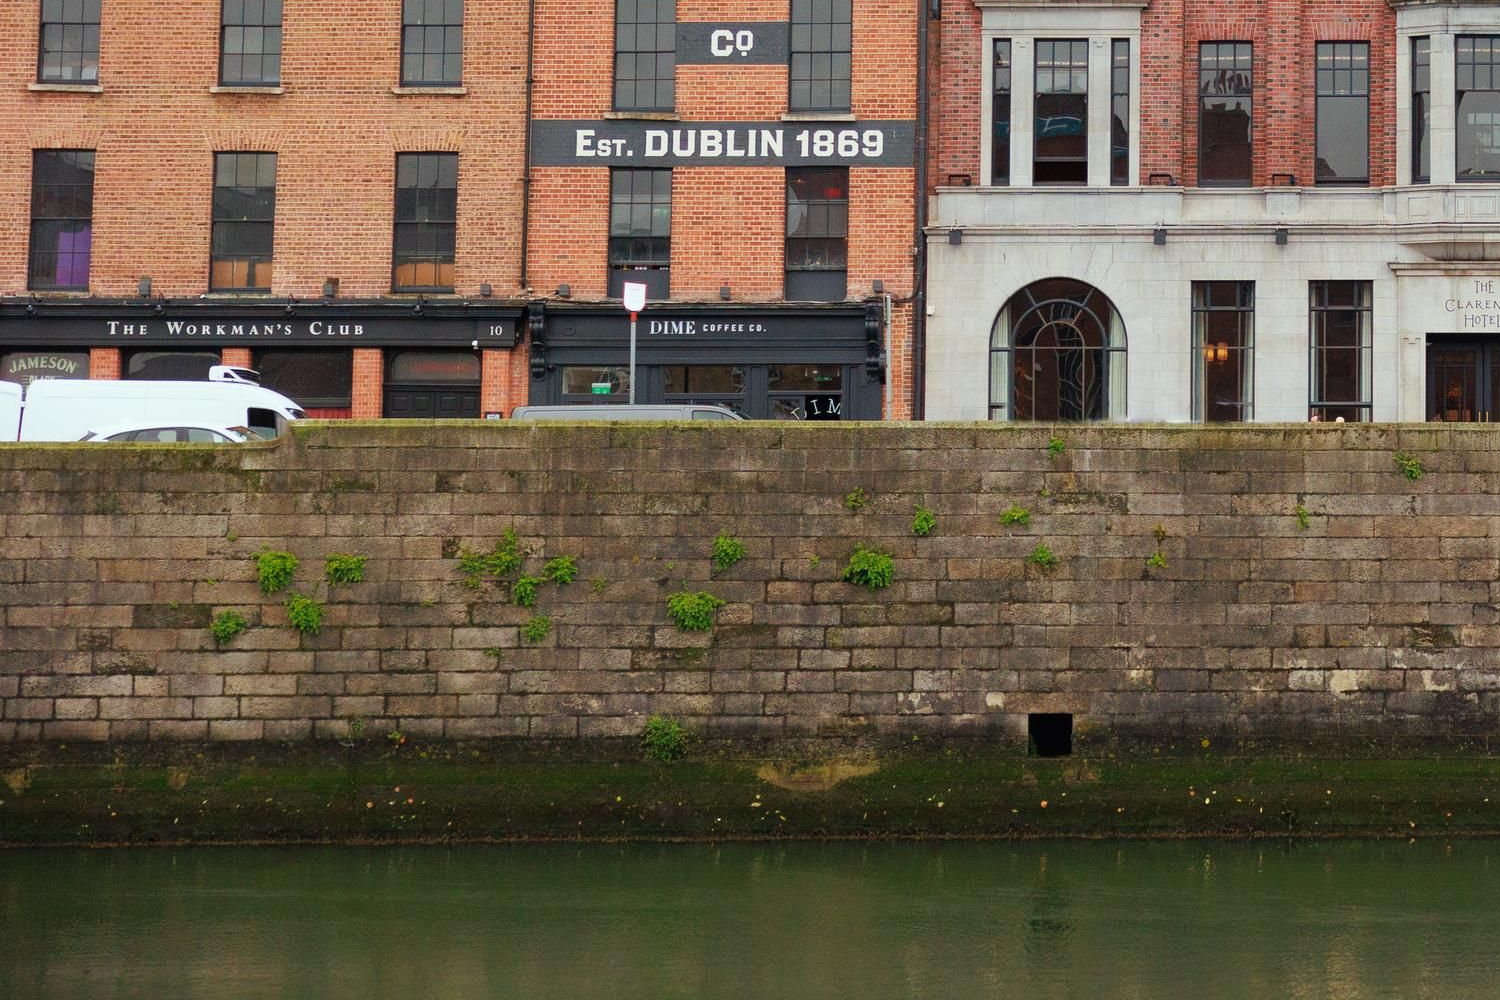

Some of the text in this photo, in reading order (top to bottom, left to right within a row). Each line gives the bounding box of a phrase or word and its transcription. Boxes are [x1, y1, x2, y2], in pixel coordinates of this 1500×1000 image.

[645, 129, 784, 157] DUBLIN
[795, 129, 884, 157] 1869
[1474, 280, 1495, 294] THE
[107, 321, 148, 335] THE
[309, 321, 364, 335] CLUB
[489, 325, 503, 336] 10
[649, 320, 767, 335] DIME COFFEE CO.
[9, 356, 77, 374] JAMESON
